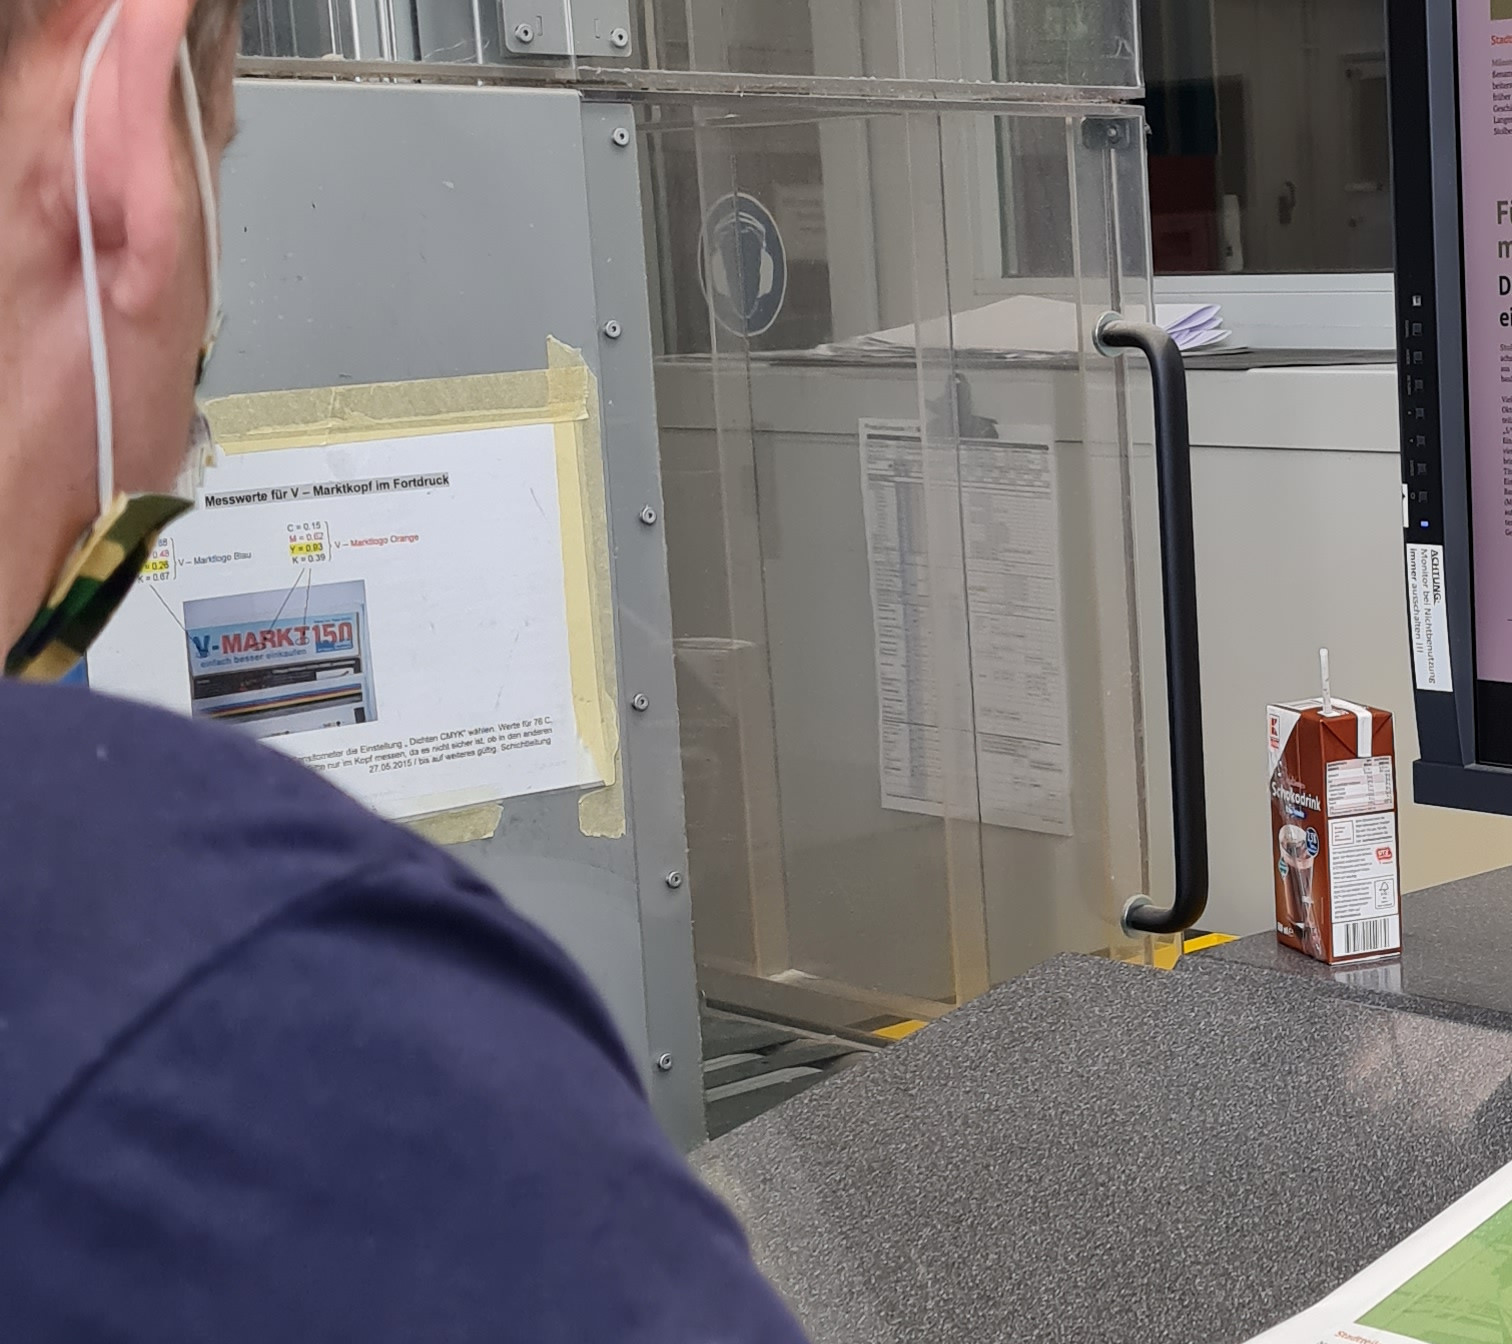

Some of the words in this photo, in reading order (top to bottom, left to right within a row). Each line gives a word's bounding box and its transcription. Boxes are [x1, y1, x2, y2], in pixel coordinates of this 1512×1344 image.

[204, 492, 268, 507] Messwerte
[271, 489, 289, 501] für
[291, 487, 300, 498] V
[313, 481, 373, 497] Marktkopf
[376, 480, 390, 491] im
[393, 474, 449, 488] Fortdruck
[1420, 548, 1429, 588] Monitor
[1412, 584, 1421, 639] ausschalten
[192, 626, 310, 659] V-MARKT
[1424, 608, 1436, 684] Nichtbenutzung
[1272, 781, 1321, 812] Schokodrink
